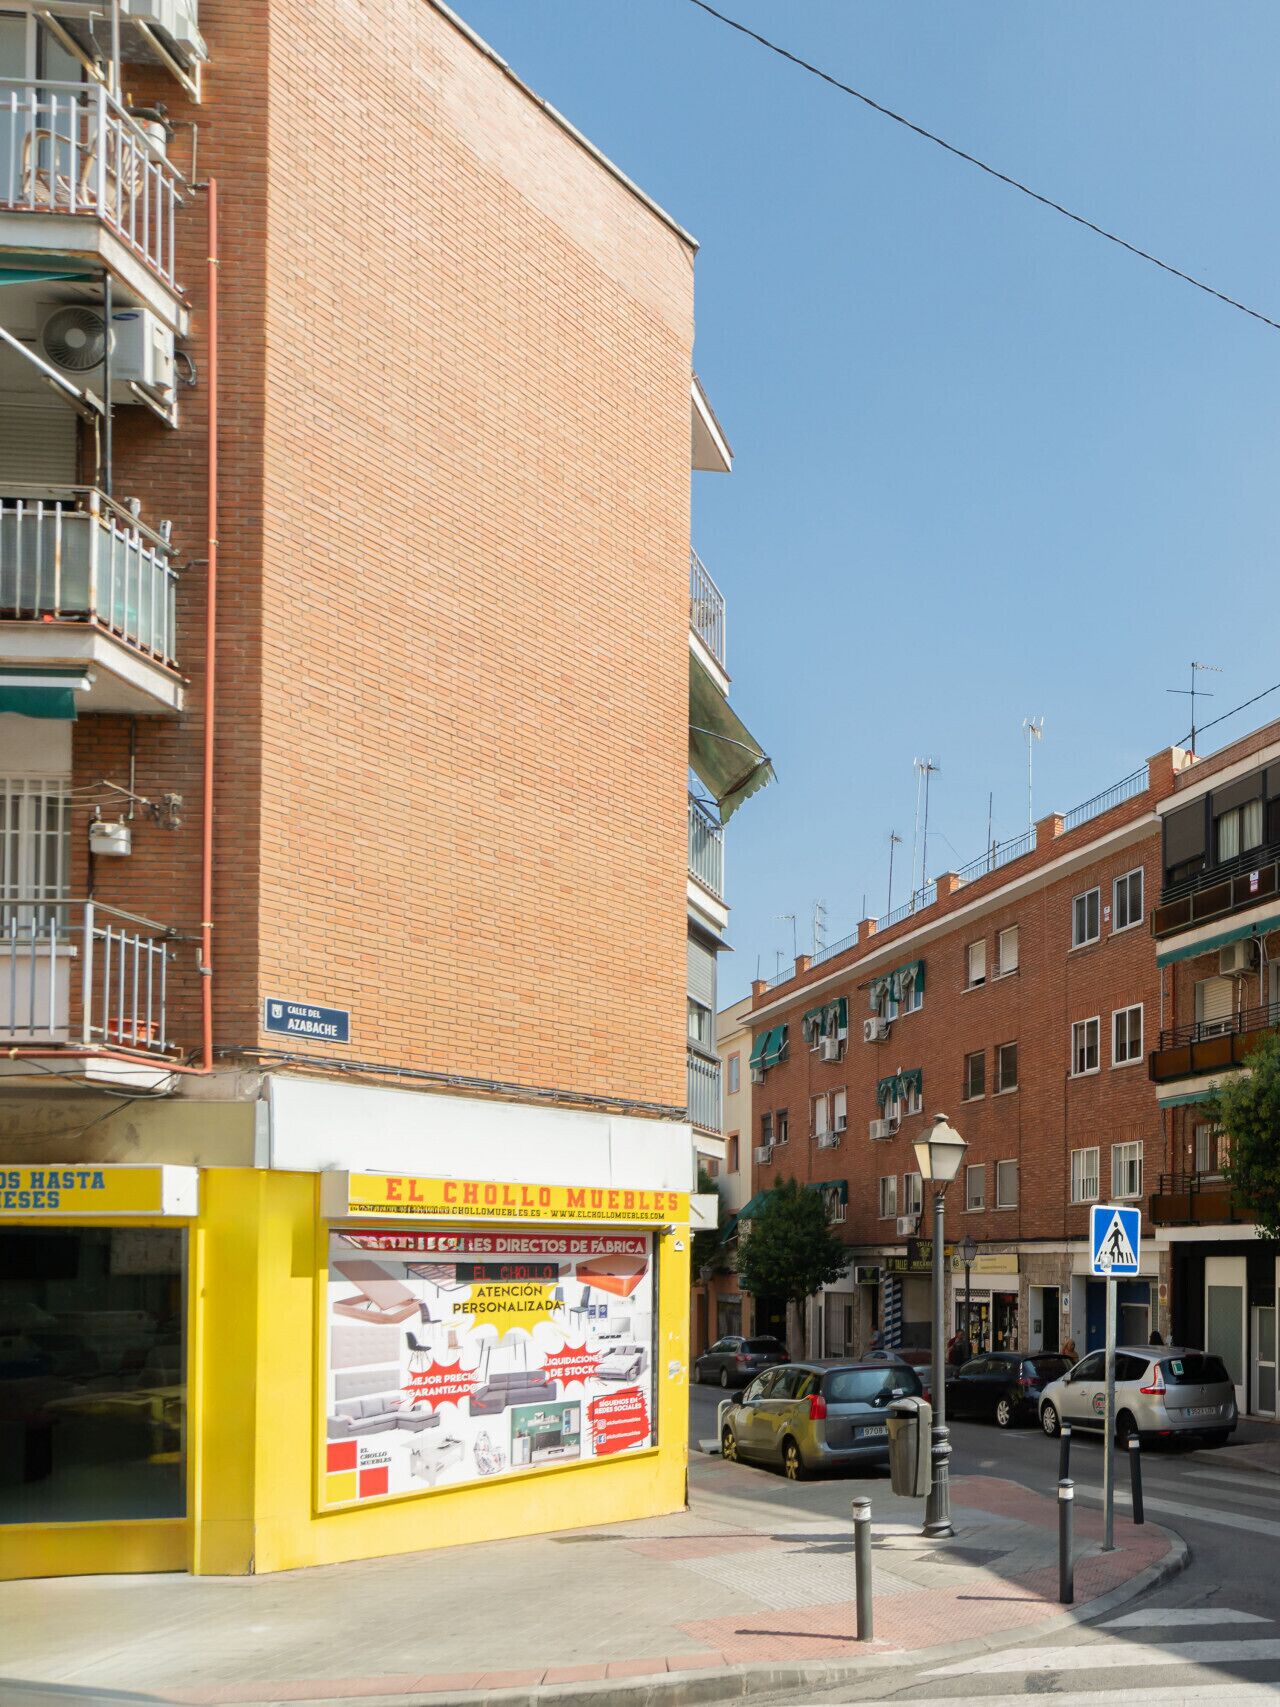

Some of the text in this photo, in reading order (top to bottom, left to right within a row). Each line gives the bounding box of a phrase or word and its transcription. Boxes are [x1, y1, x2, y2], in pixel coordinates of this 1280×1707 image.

[288, 1006, 322, 1019] CALLE DEL
[288, 1018, 338, 1036] AZABACHE
[30, 1172, 106, 1189] HASTA
[0, 1191, 60, 1209] ESES
[386, 1178, 679, 1212] EL CHOLLO MUEBLES
[550, 1209, 666, 1221] WWW.ELCHOLLOMUEBLES.COM
[496, 1237, 567, 1253] DIRECTOS
[571, 1239, 588, 1253] DE
[590, 1237, 645, 1254] FÁBRICA
[474, 1264, 553, 1280] EL CHOLLO
[477, 1282, 543, 1297] ATENCIÓN
[453, 1300, 562, 1315] PERSONALIZADA
[550, 1365, 595, 1378] DE STOCK
